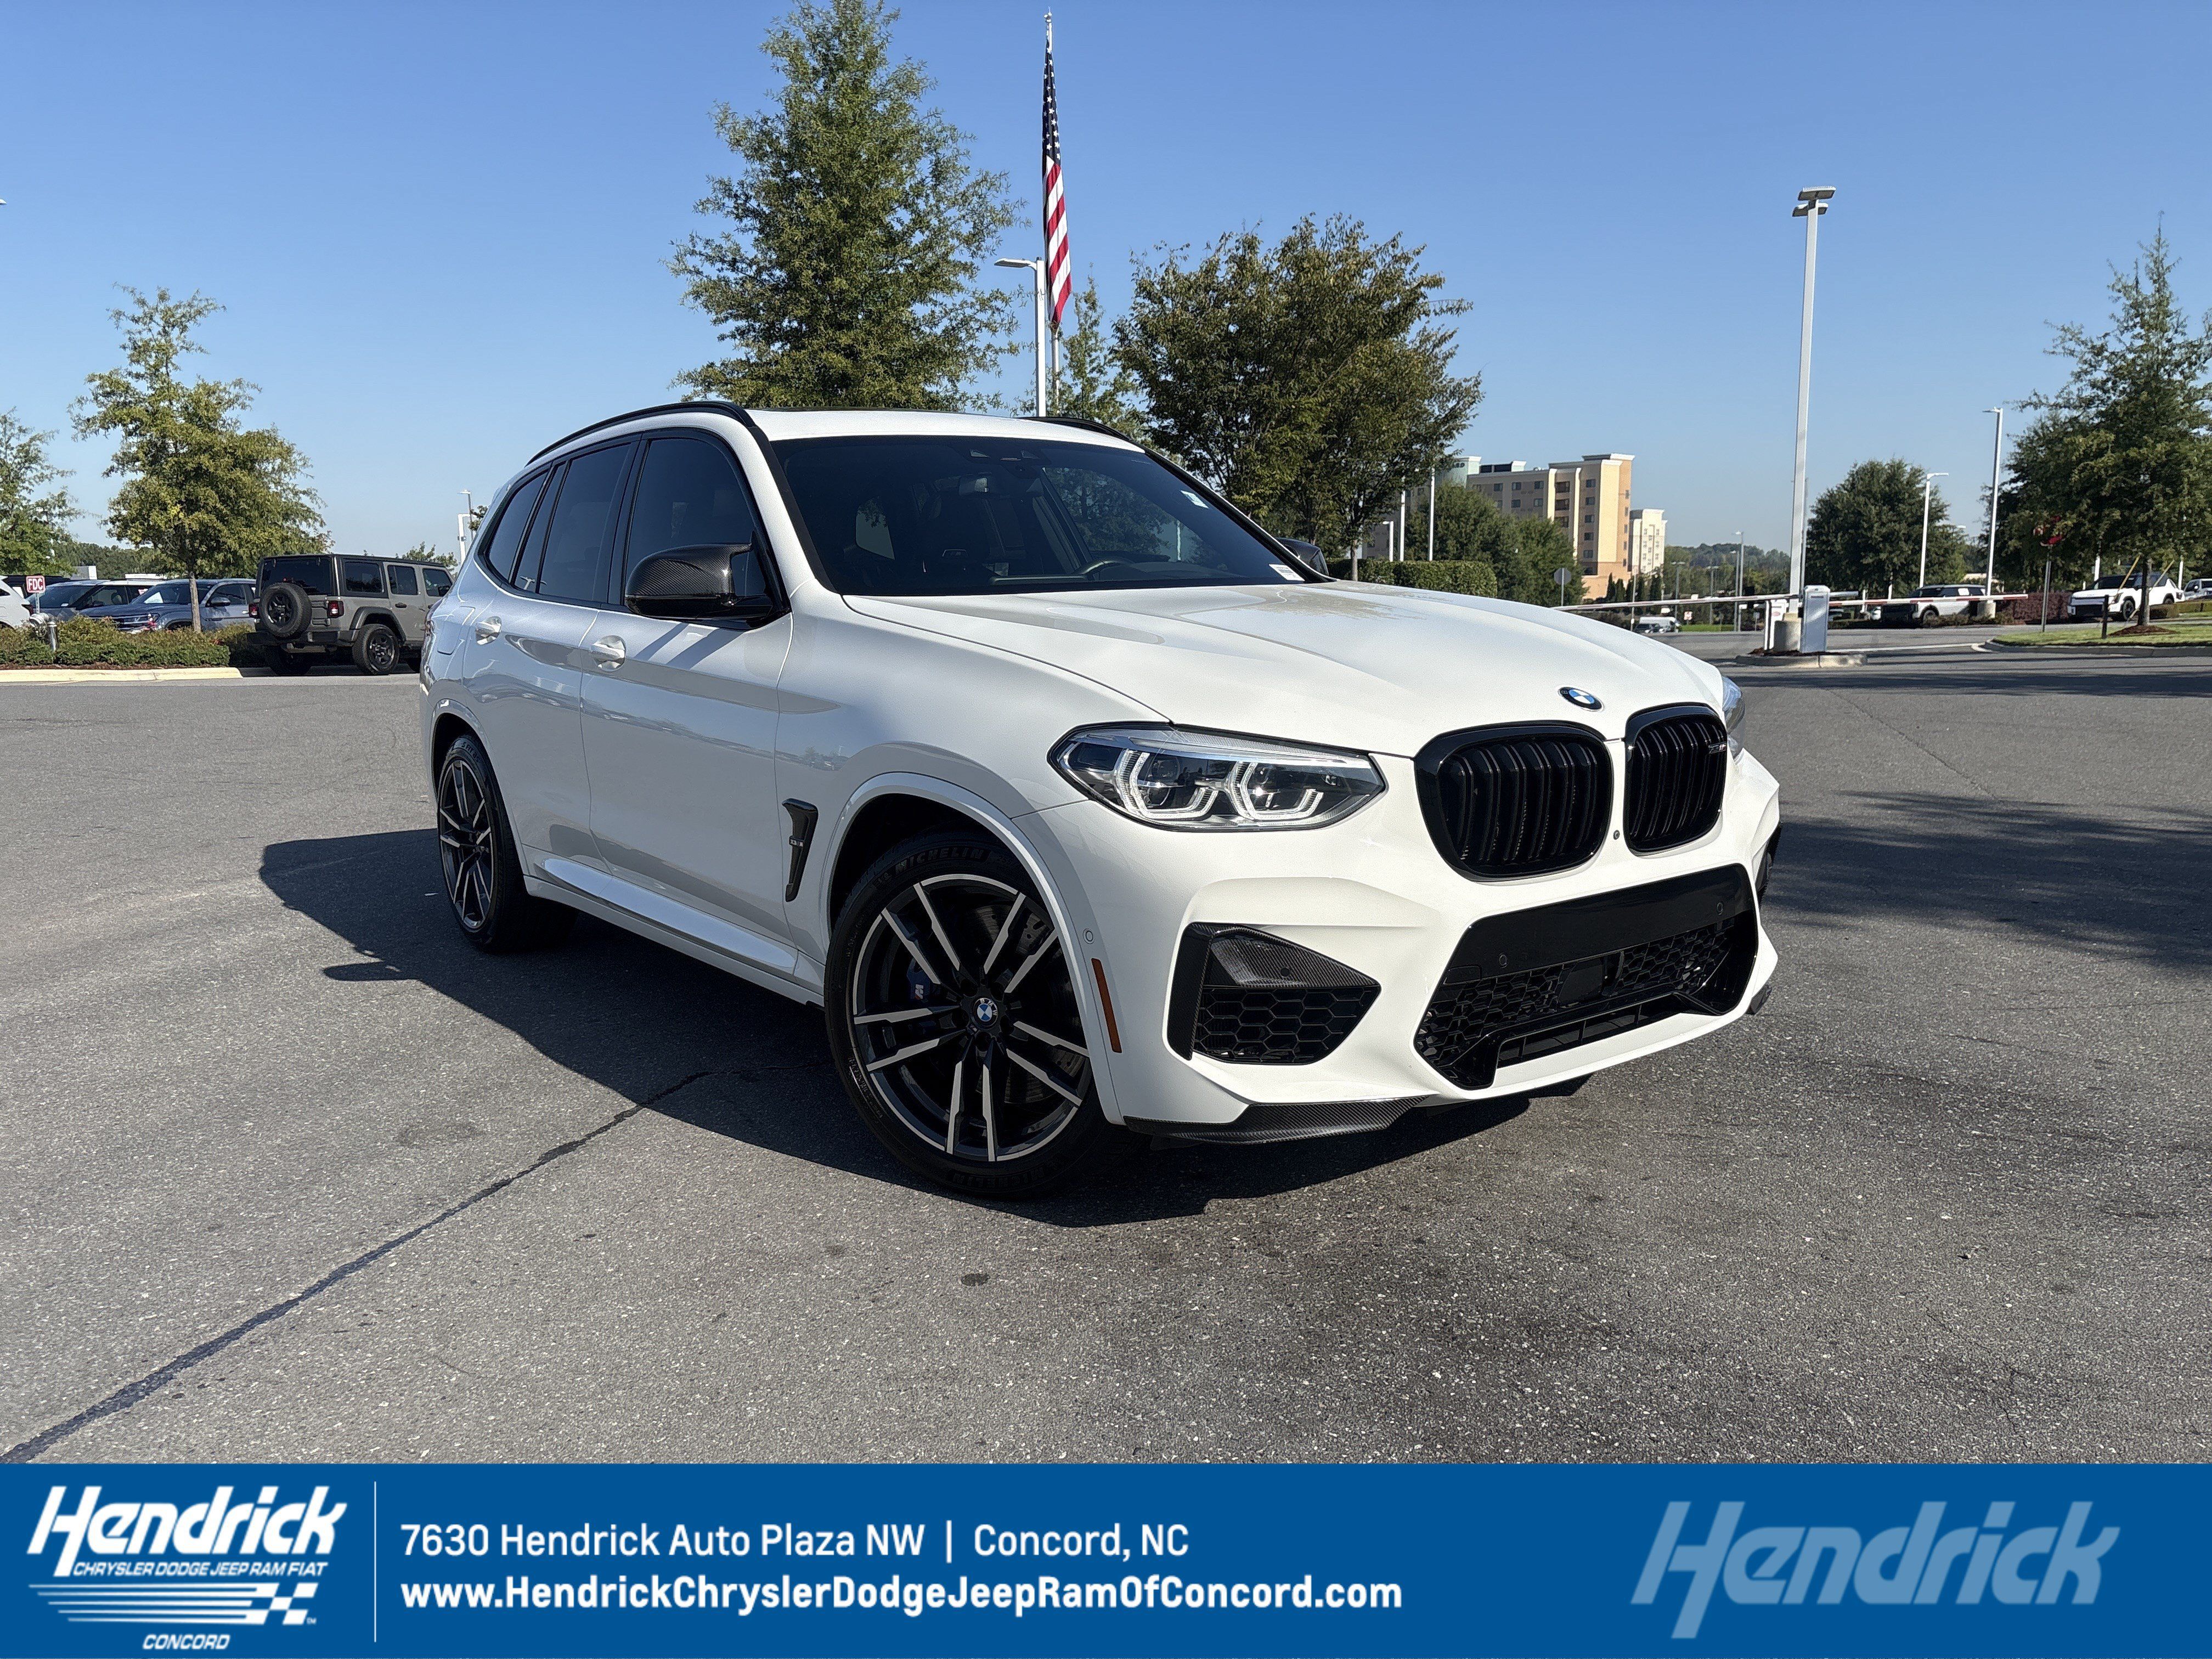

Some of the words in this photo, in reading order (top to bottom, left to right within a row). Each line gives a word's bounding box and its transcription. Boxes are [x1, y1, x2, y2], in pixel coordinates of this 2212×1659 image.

[28, 578, 43, 590] FDC
[895, 846, 985, 874] MICHELIN
[980, 998, 998, 1016] BMW
